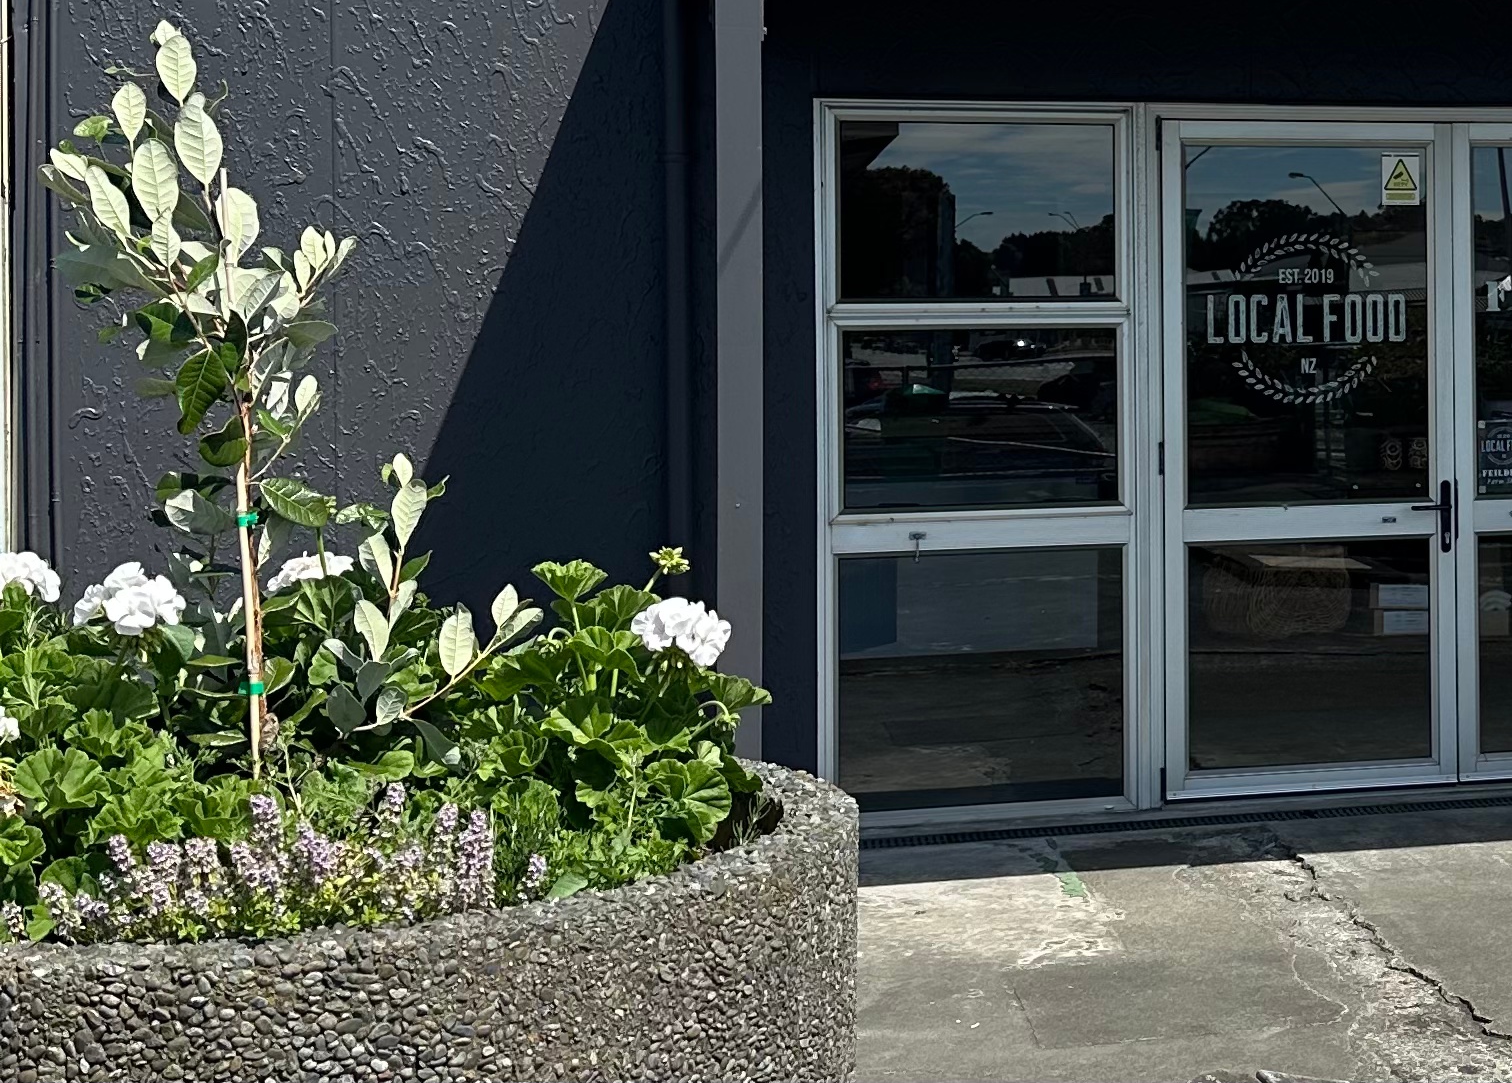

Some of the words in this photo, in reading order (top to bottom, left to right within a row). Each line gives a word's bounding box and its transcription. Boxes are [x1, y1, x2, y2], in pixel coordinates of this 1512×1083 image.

[1278, 268, 1302, 284] EST.
[1304, 268, 1334, 284] 2019
[1206, 293, 1314, 344] LOCAL
[1322, 293, 1407, 344] FOOD
[1300, 357, 1317, 374] NZ
[1480, 439, 1506, 452] LOCAL
